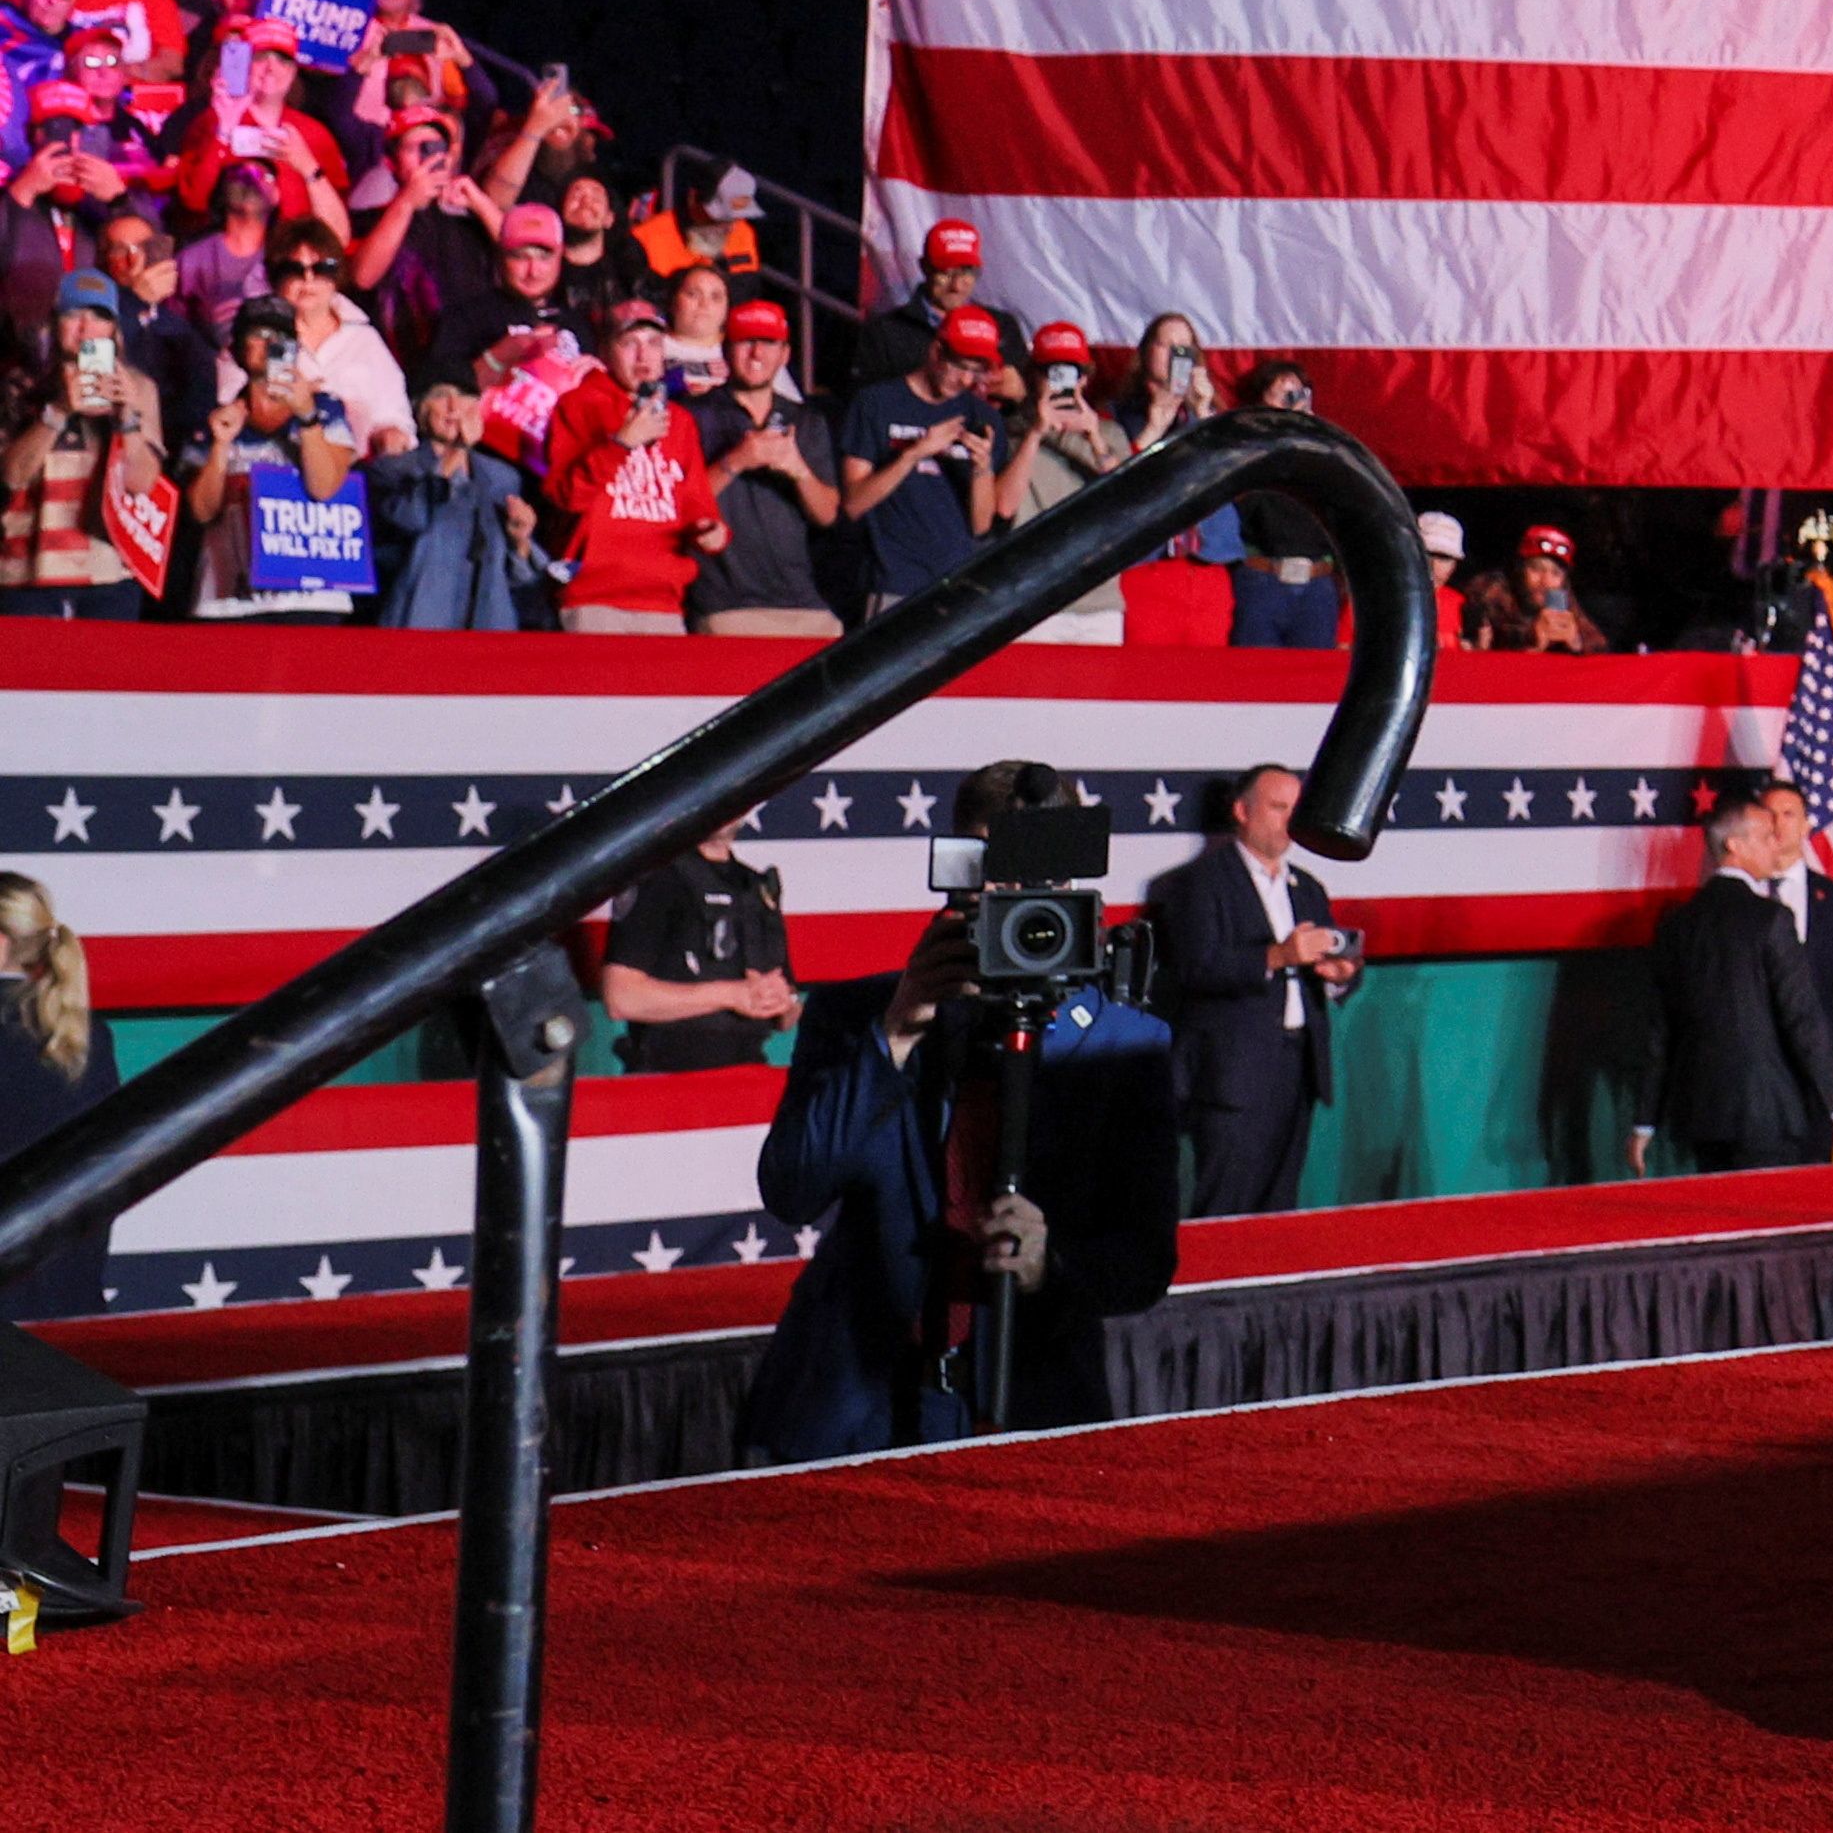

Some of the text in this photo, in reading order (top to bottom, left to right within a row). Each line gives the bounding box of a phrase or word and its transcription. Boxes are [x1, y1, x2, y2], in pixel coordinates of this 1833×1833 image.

[258, 497, 363, 539] TRUMP
[261, 531, 364, 561] WILL FIX IT
